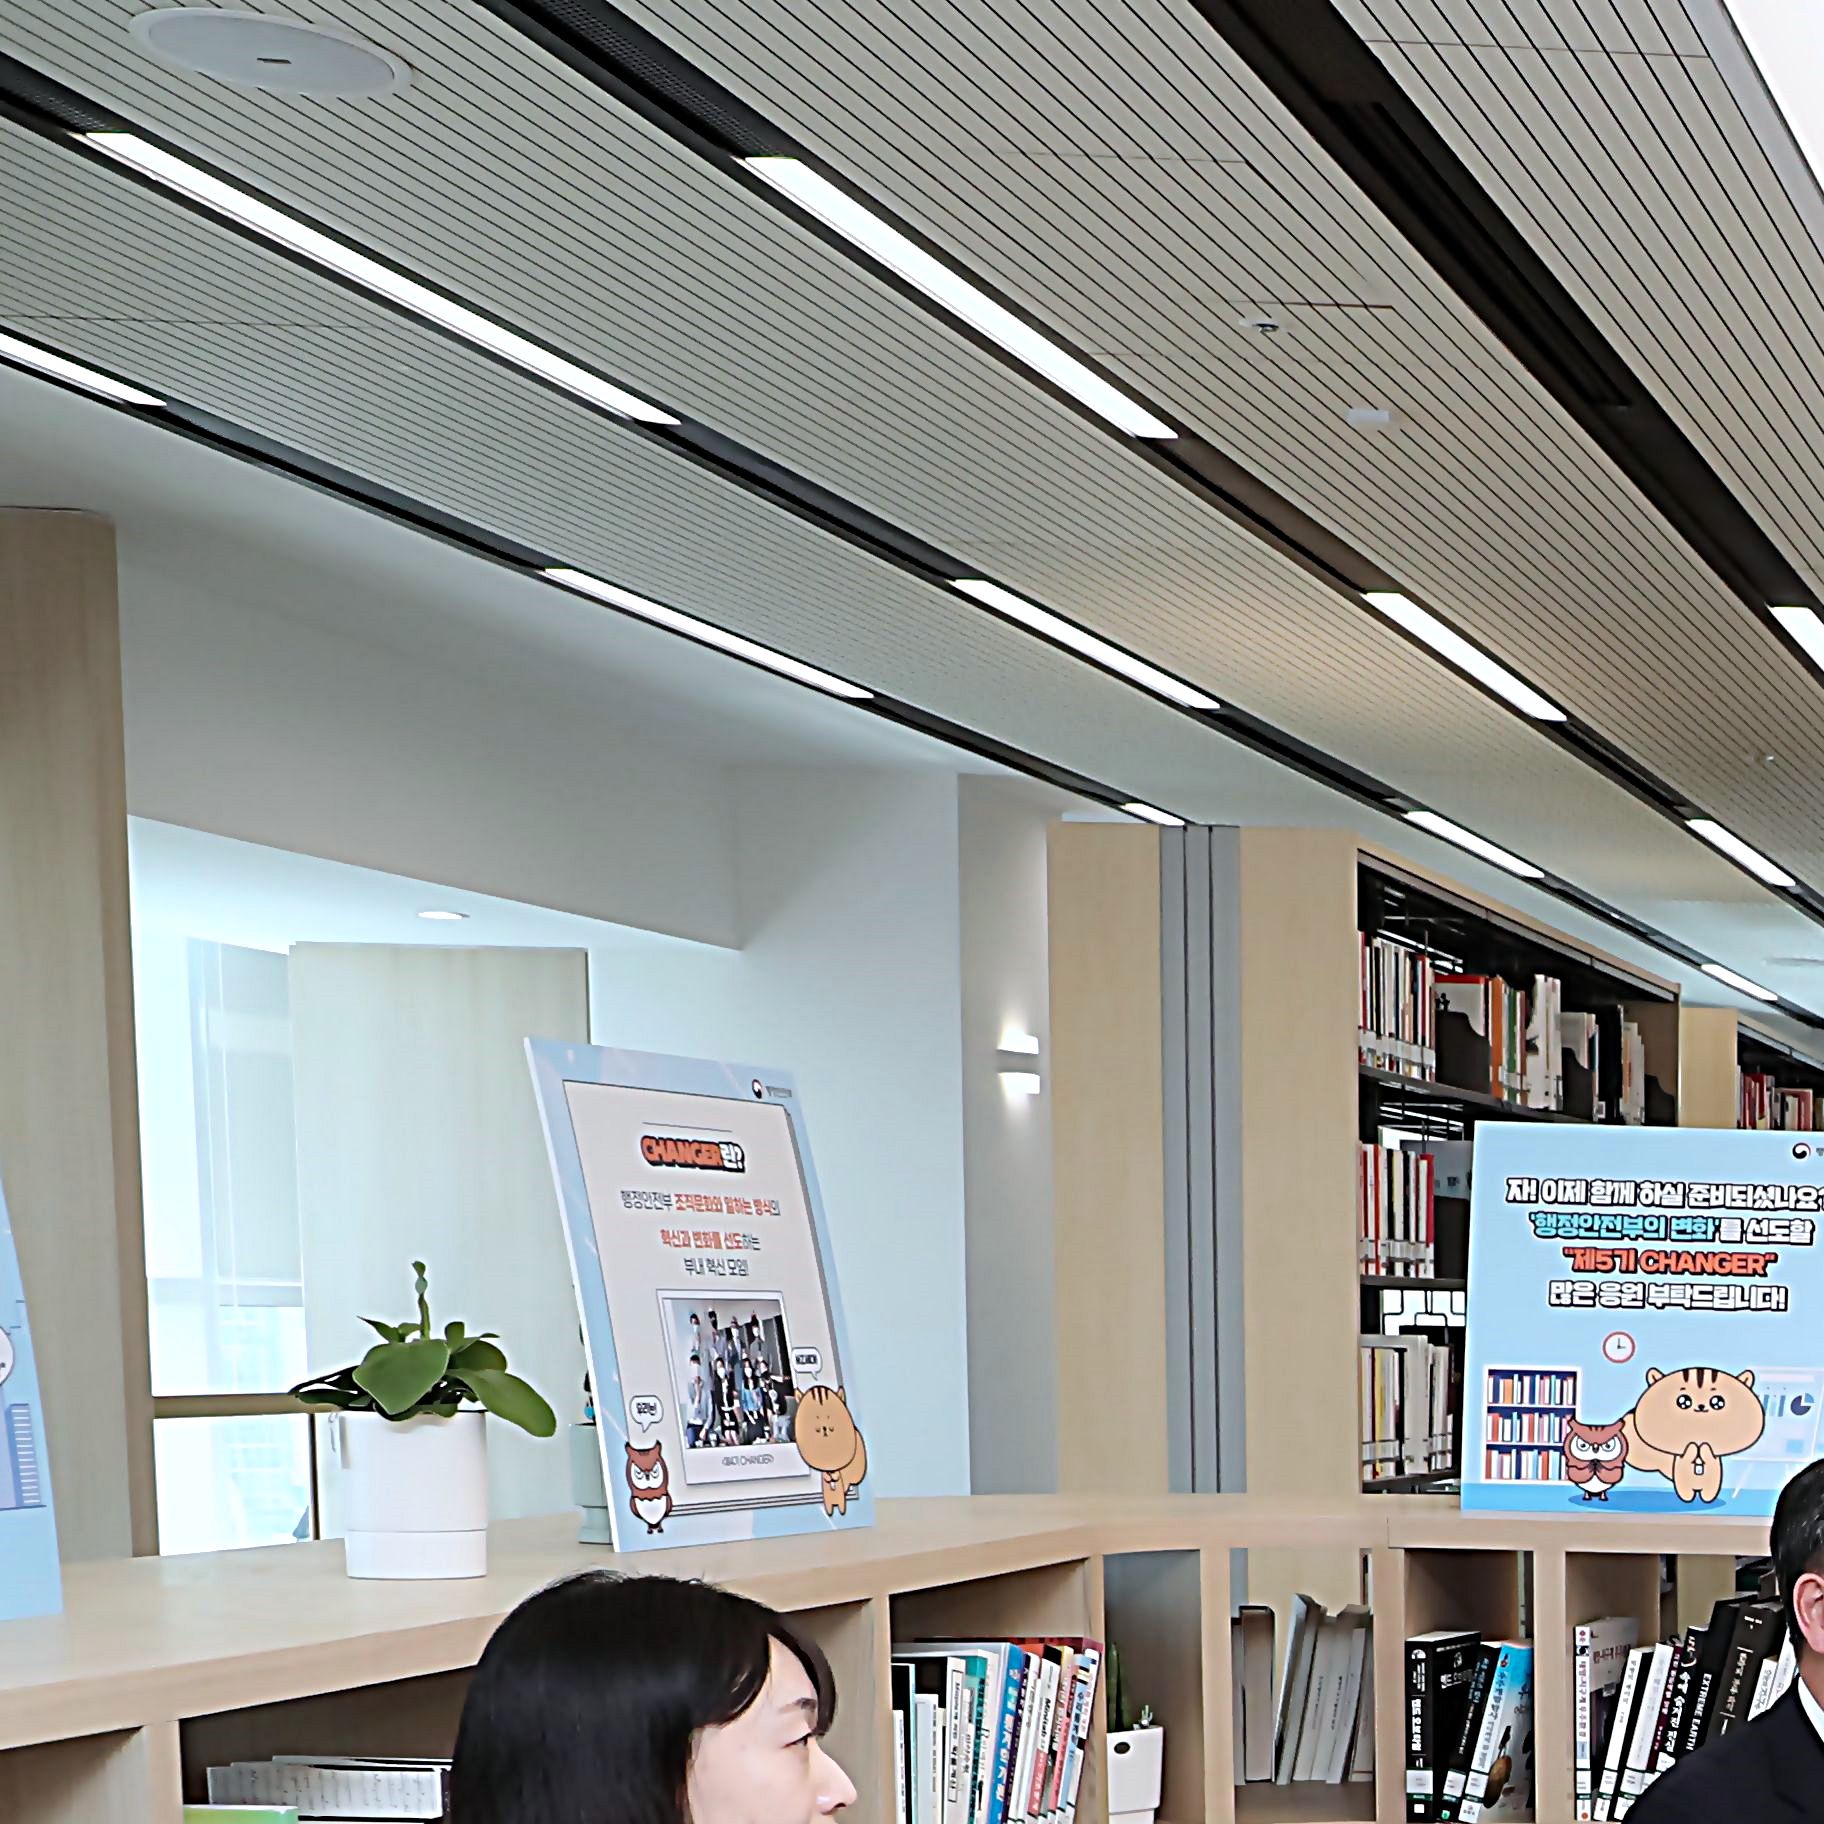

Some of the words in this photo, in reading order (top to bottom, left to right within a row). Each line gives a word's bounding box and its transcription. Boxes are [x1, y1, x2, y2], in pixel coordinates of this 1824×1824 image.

[1506, 1178, 1538, 1204] 자!
[1541, 1179, 1587, 1205] 이제
[1590, 1179, 1637, 1207] 함께
[1639, 1181, 1686, 1208] 하실
[1529, 1211, 1667, 1239] '행정안전부의
[1745, 1218, 1816, 1245] 선도할
[1549, 1281, 1596, 1308] 많은
[1598, 1282, 1645, 1309] 응원
[1647, 1282, 1788, 1311] 부탁드립니다!
[1694, 1673, 1712, 1716] EXTREME
[1686, 1717, 1702, 1751] EARTH
